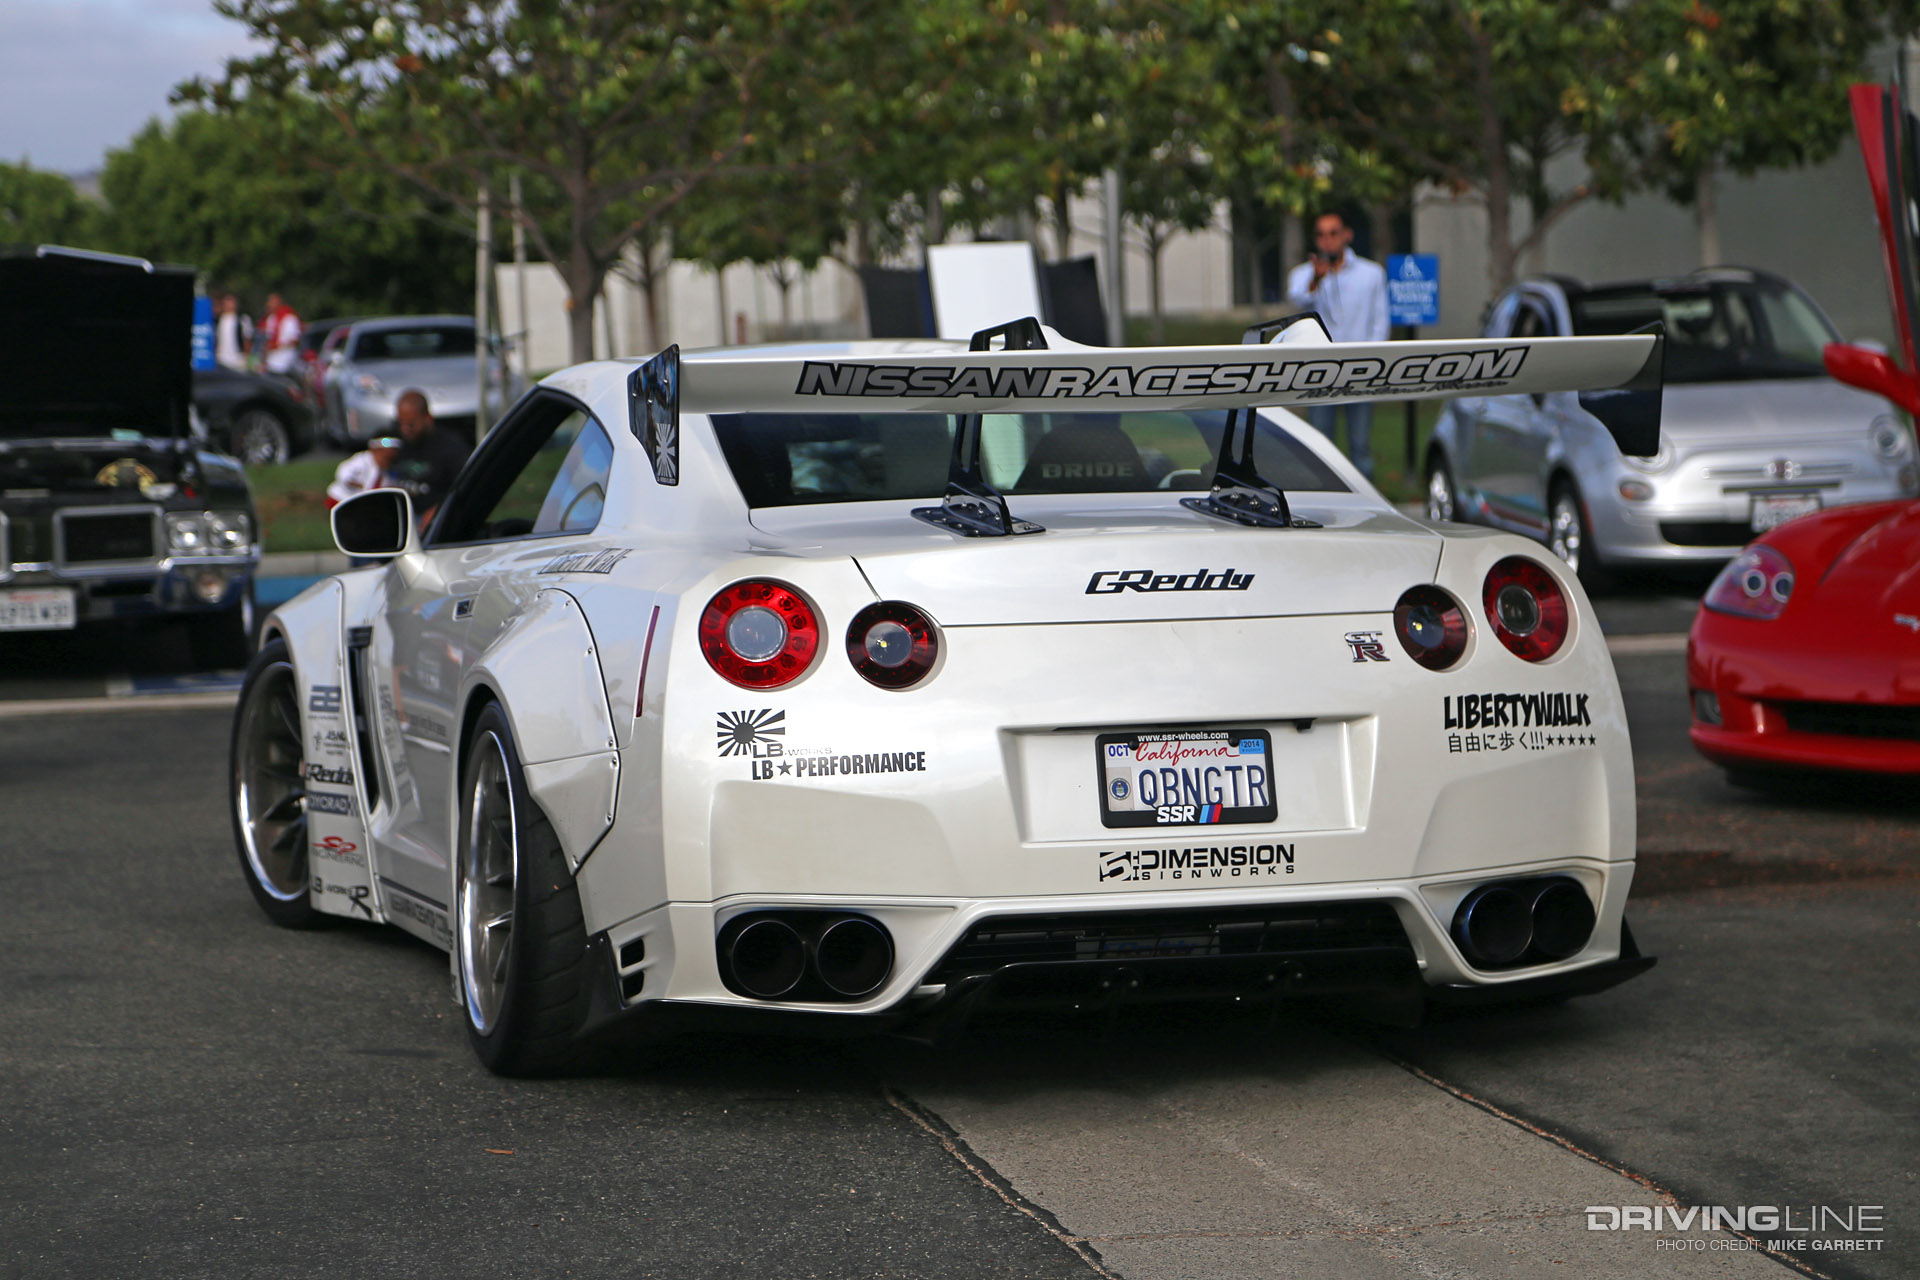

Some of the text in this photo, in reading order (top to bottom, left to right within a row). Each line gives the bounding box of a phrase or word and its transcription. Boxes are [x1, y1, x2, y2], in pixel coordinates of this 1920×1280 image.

[795, 345, 1530, 399] NISSANRACESHOP.COM
[1040, 461, 1135, 479] BRIDE
[1085, 568, 1256, 595] GReddy
[1137, 731, 1229, 743] www.ssr-wheels.com
[796, 752, 926, 778] PERFORMANCE
[1108, 740, 1261, 767] OCT California 2014
[1138, 765, 1268, 808] QBNGTR
[1157, 804, 1196, 823] SSR
[1141, 843, 1295, 870] DIMENSION
[1141, 865, 1295, 881] SIGNWORKS
